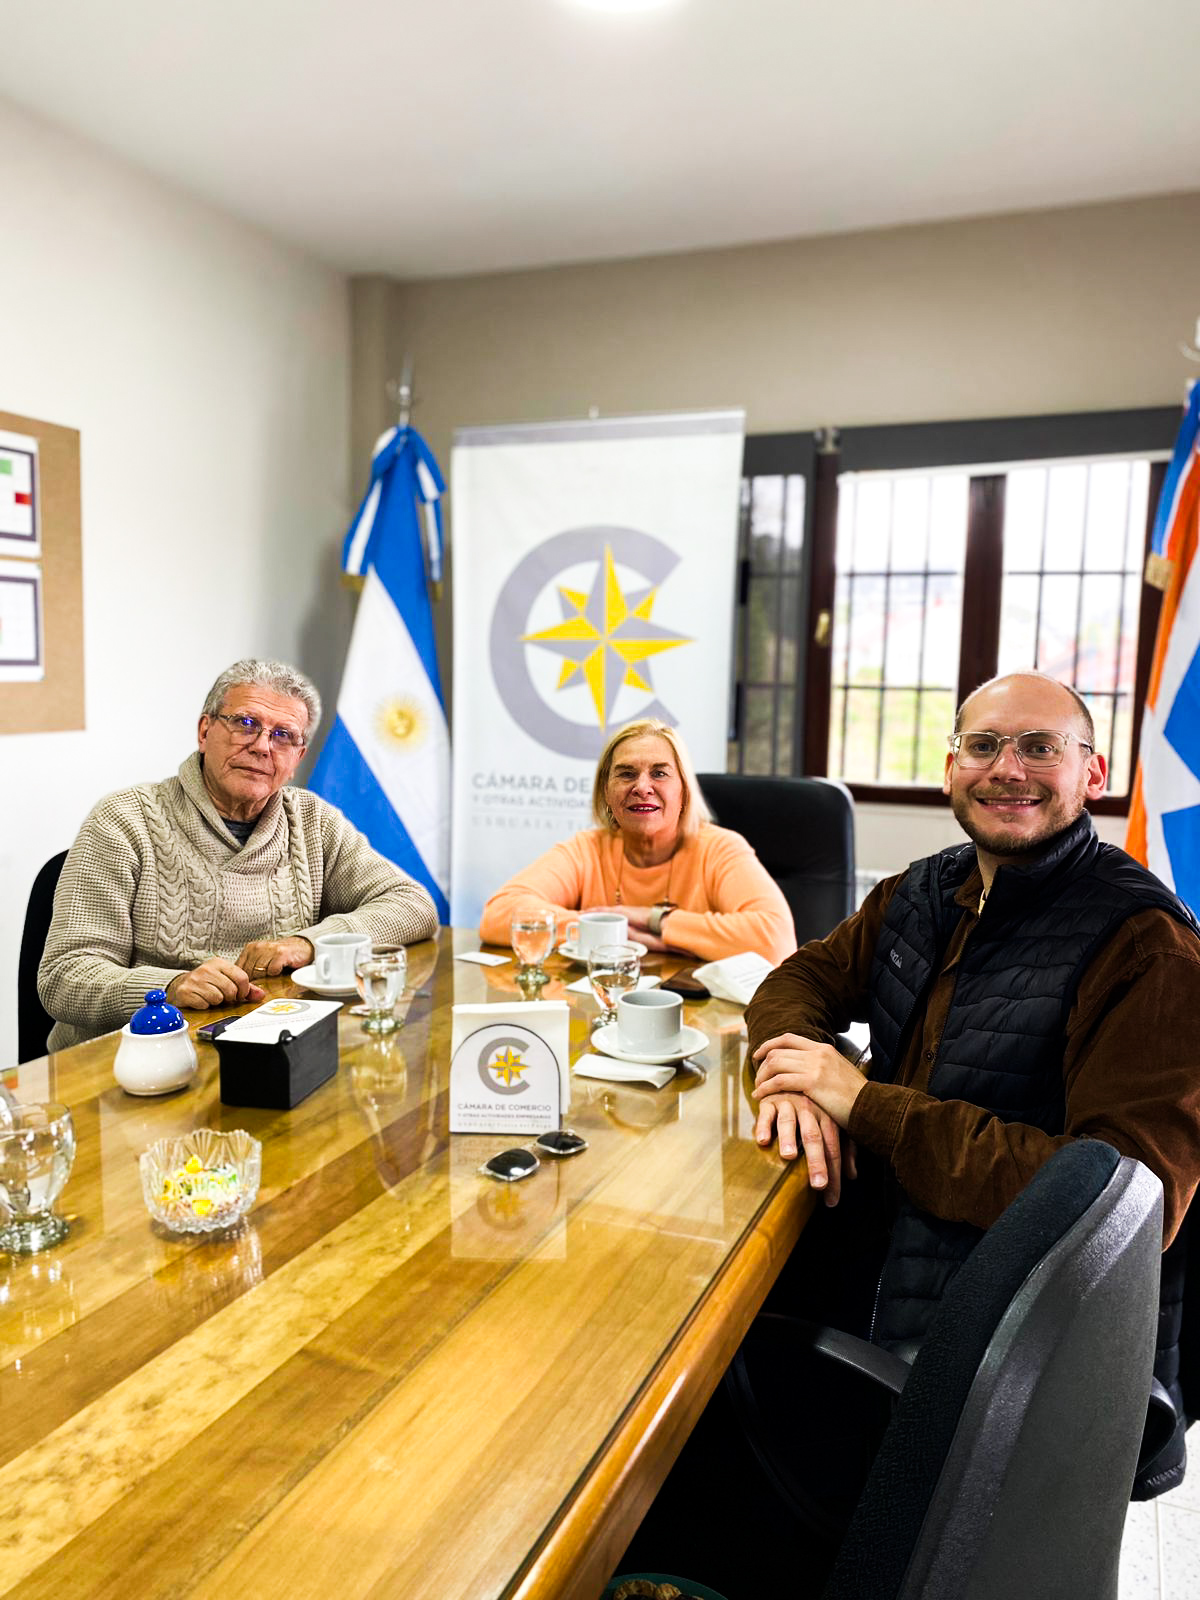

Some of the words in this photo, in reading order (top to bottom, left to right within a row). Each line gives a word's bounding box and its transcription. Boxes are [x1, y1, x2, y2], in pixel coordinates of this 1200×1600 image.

[471, 769, 558, 792] CÁMARA
[564, 776, 591, 794] DE
[457, 1102, 493, 1110] CÁMARA
[495, 1103, 506, 1111] DE
[508, 1104, 552, 1112] COMERCIO
